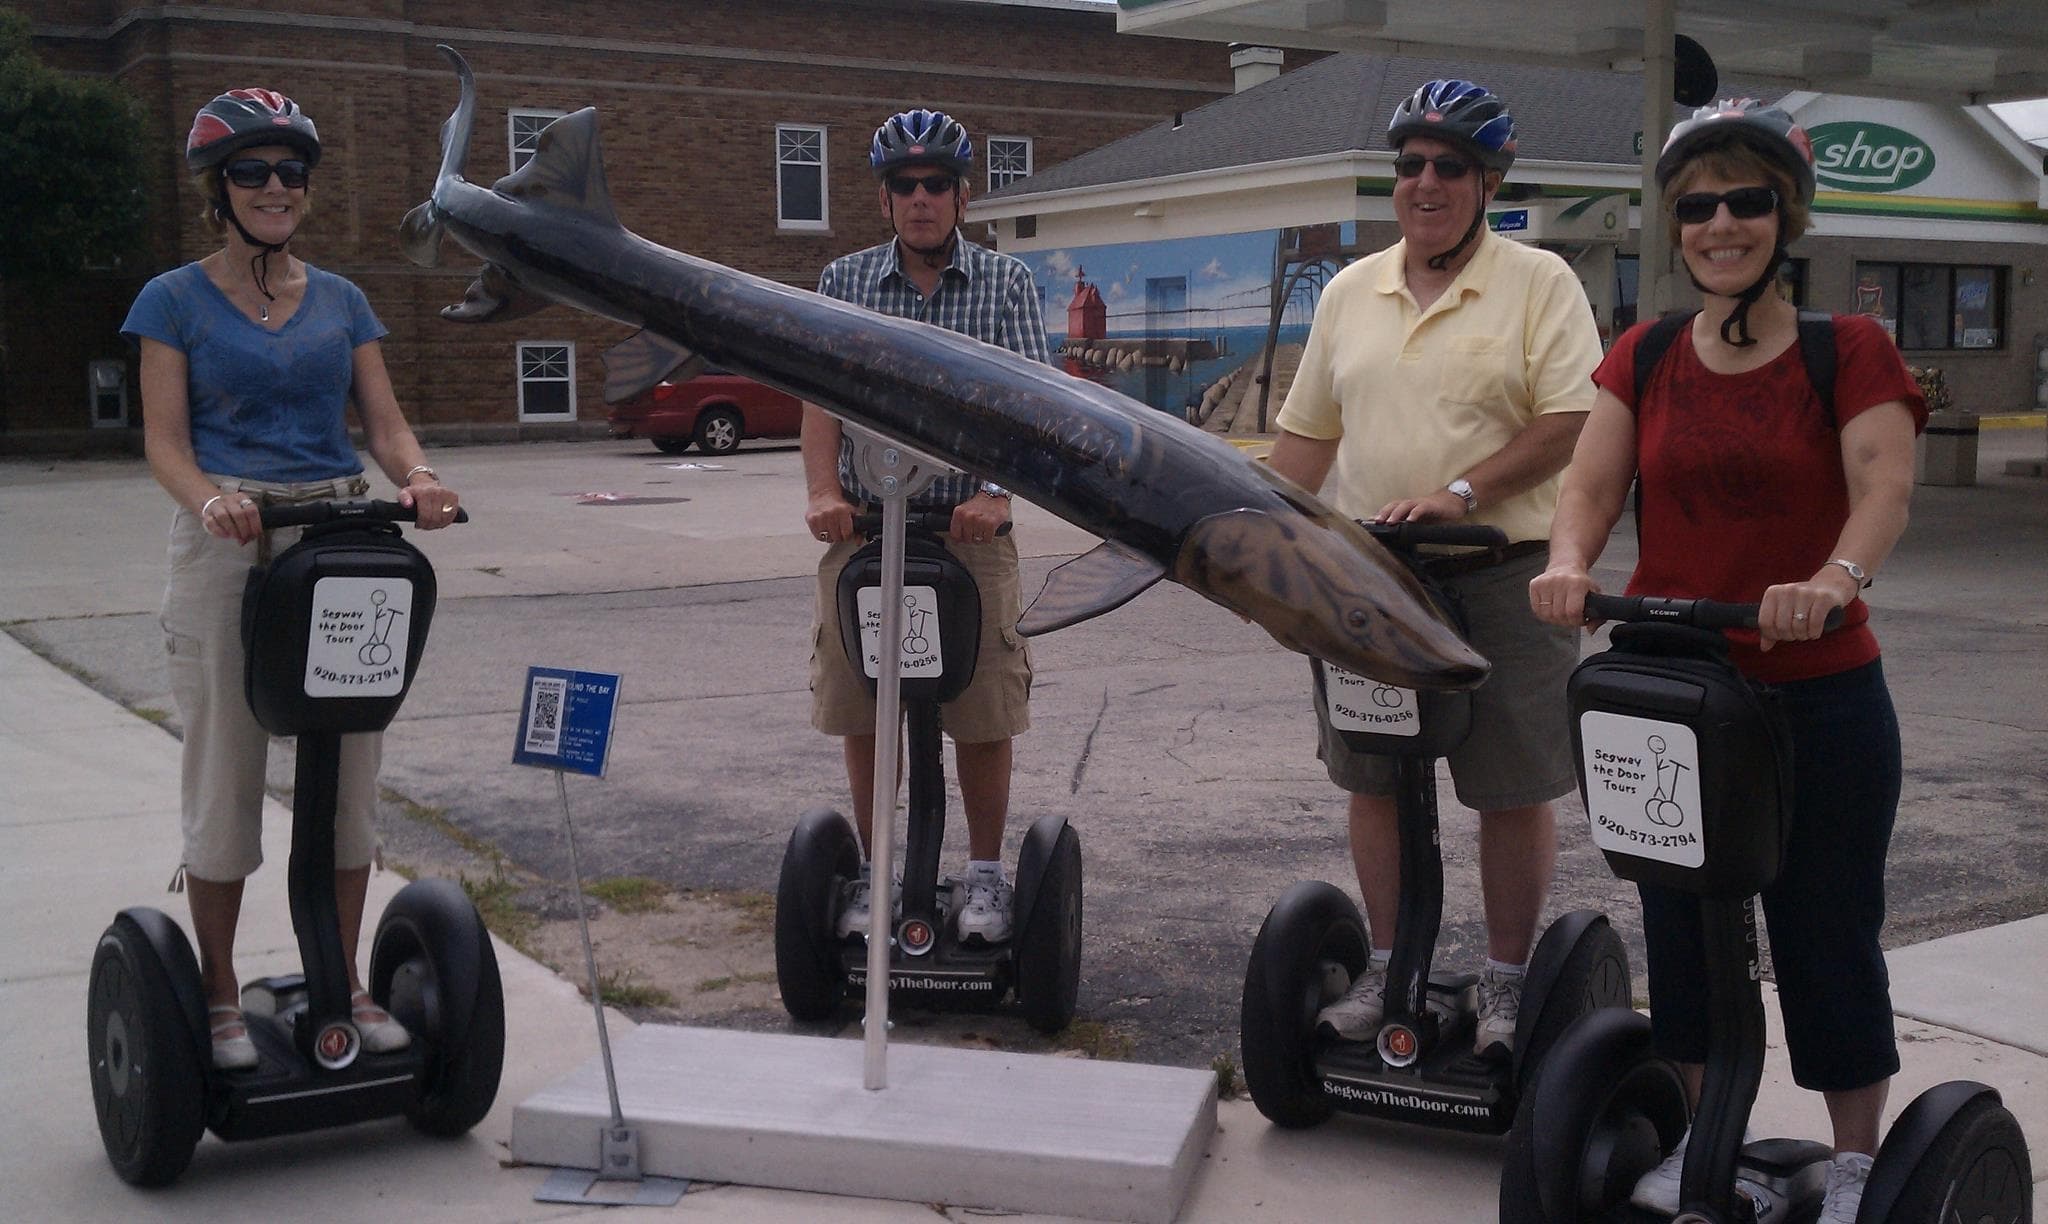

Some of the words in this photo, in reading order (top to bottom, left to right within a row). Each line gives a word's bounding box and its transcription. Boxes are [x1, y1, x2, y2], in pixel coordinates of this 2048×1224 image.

[1817, 131, 1924, 183] shop
[322, 609, 364, 620] Segway
[319, 622, 337, 632] the
[340, 622, 365, 632] Door
[326, 635, 355, 644] Tours
[313, 666, 399, 685] 920-573-2794
[1338, 676, 1366, 687] Tours
[1335, 703, 1414, 723] 920-376-0256
[1594, 749, 1642, 767] Segway
[1593, 764, 1614, 777] the
[1617, 767, 1647, 781] Door
[1603, 779, 1637, 794] Tours
[1598, 814, 1697, 847] 920-573-2794
[1322, 1080, 1490, 1117] SegwayTheDoor.com
